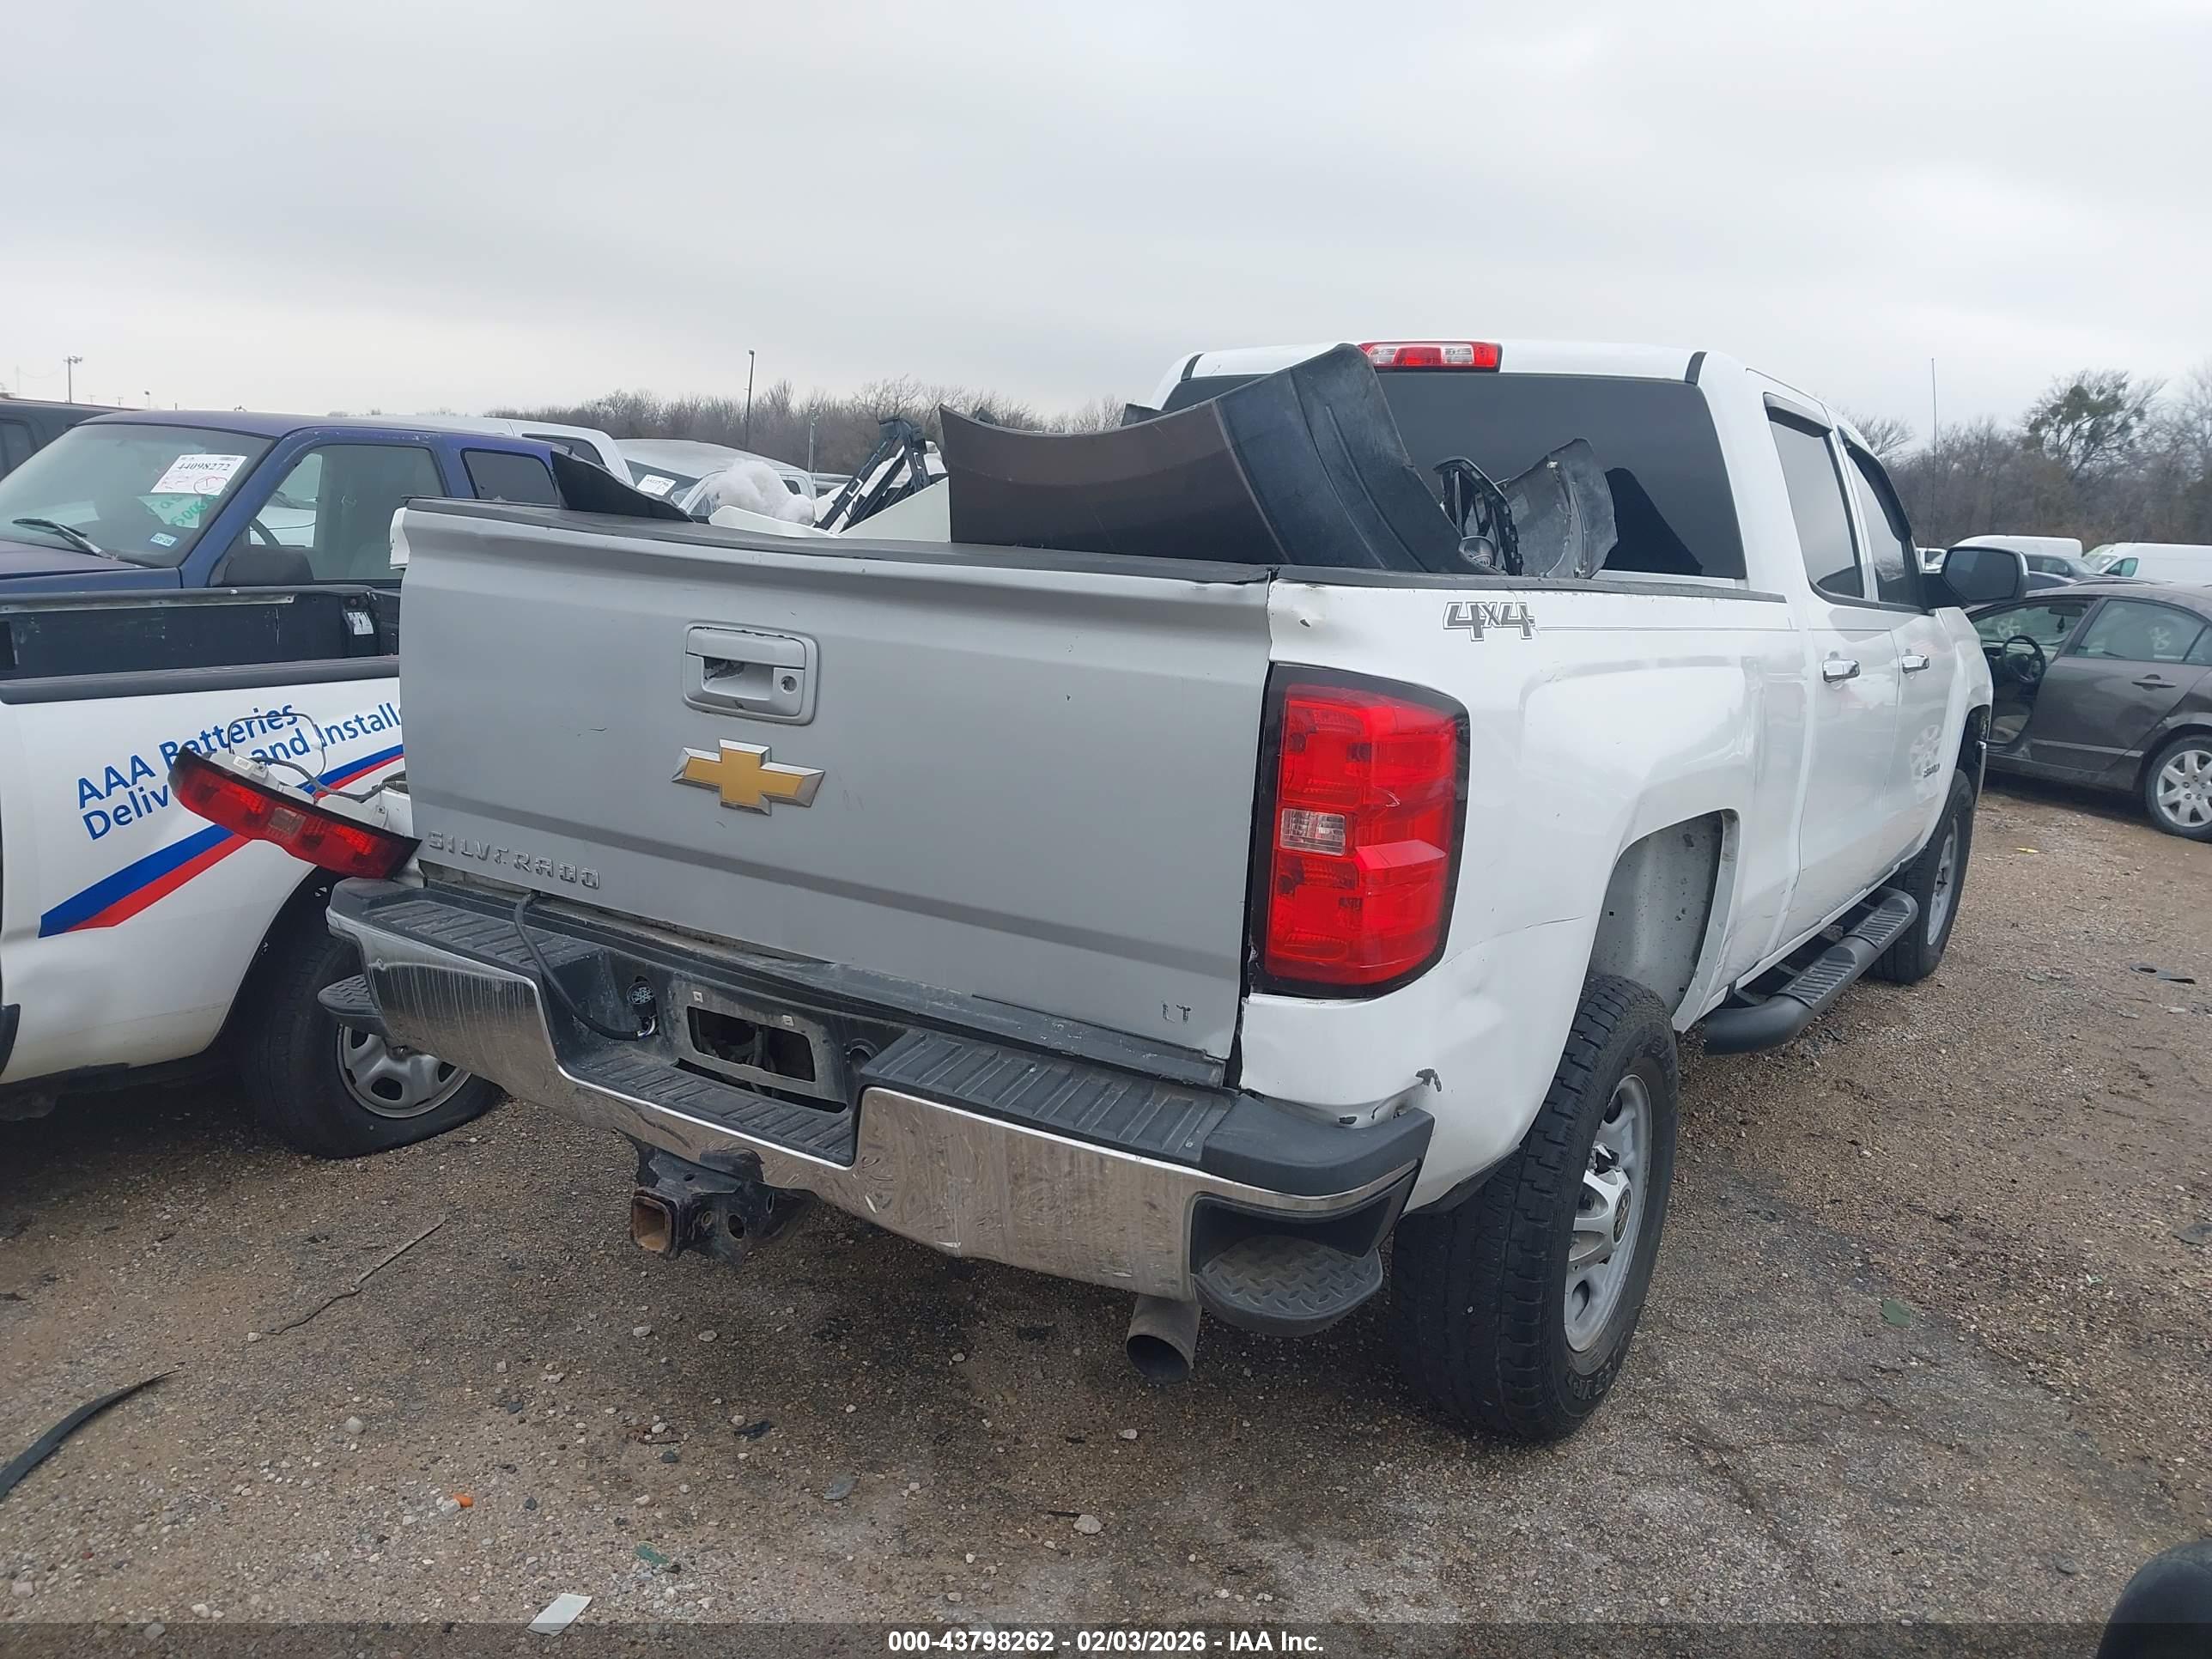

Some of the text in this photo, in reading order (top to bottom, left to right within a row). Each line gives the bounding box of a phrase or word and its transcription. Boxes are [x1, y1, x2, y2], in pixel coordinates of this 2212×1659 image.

[177, 462, 231, 471] 44098272
[252, 727, 311, 766] and
[314, 702, 401, 747] Install
[78, 754, 156, 810] AAA
[428, 830, 600, 890] SILVERADO
[1162, 1003, 1192, 1024] LT
